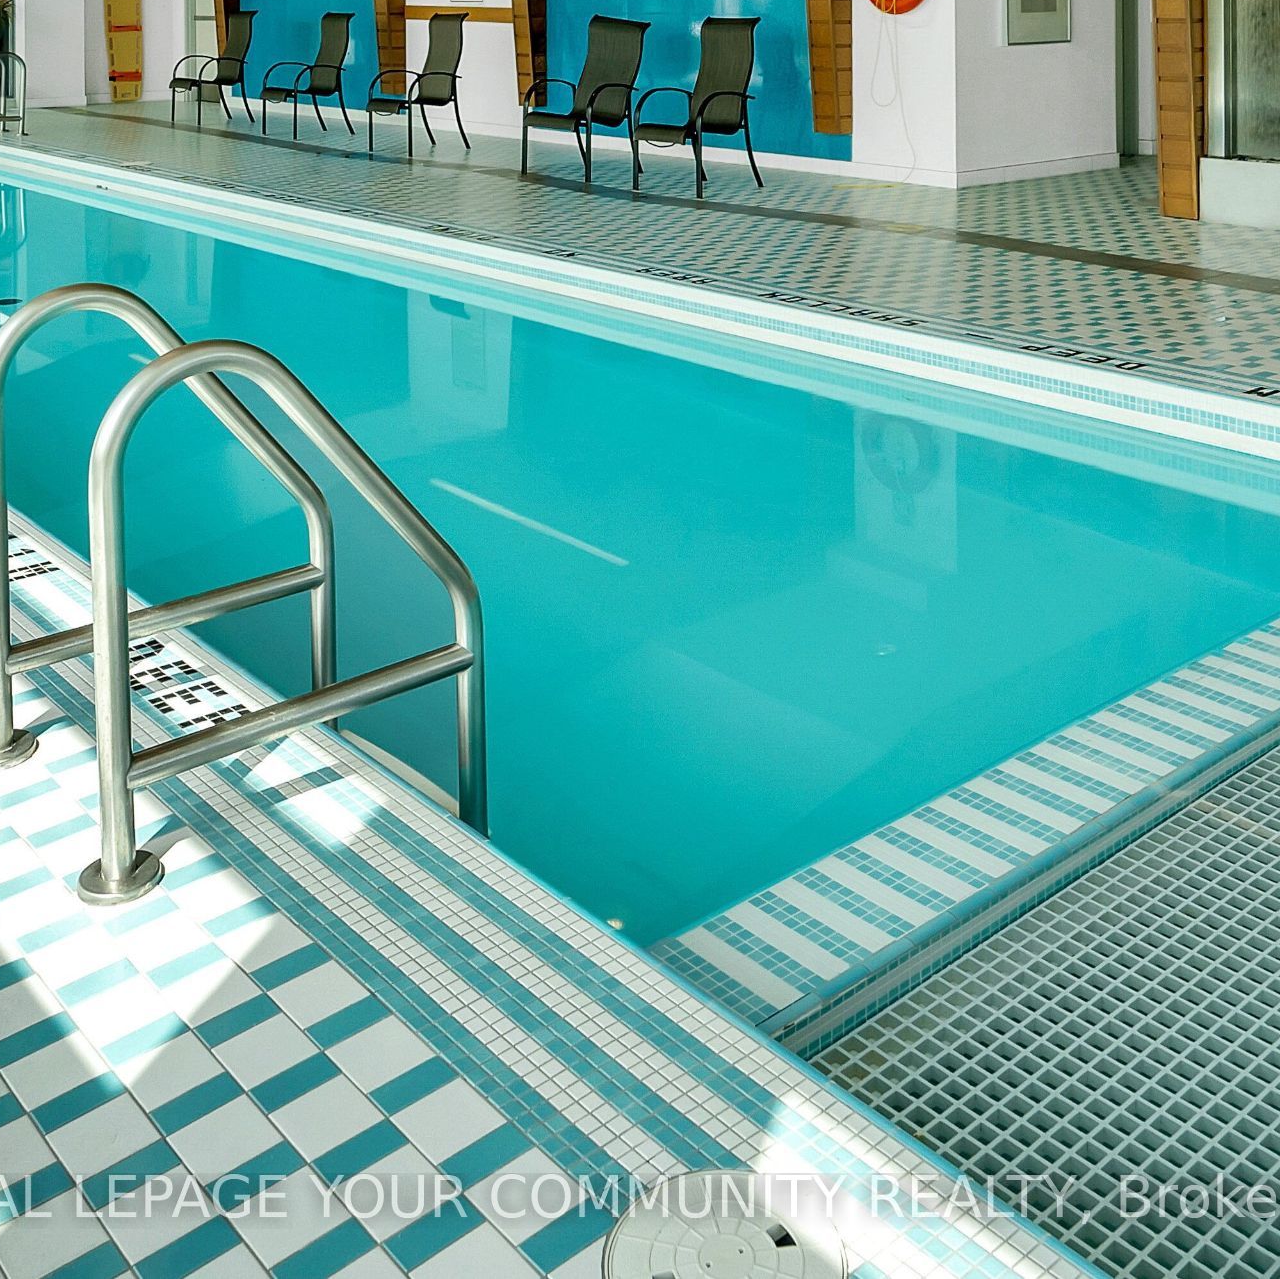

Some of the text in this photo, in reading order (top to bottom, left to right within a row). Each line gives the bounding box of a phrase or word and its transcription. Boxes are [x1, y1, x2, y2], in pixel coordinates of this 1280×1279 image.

[542, 248, 581, 258] NO
[635, 267, 719, 285] AREA
[758, 291, 929, 326] SHALLOW
[1021, 344, 1148, 371] DEEP
